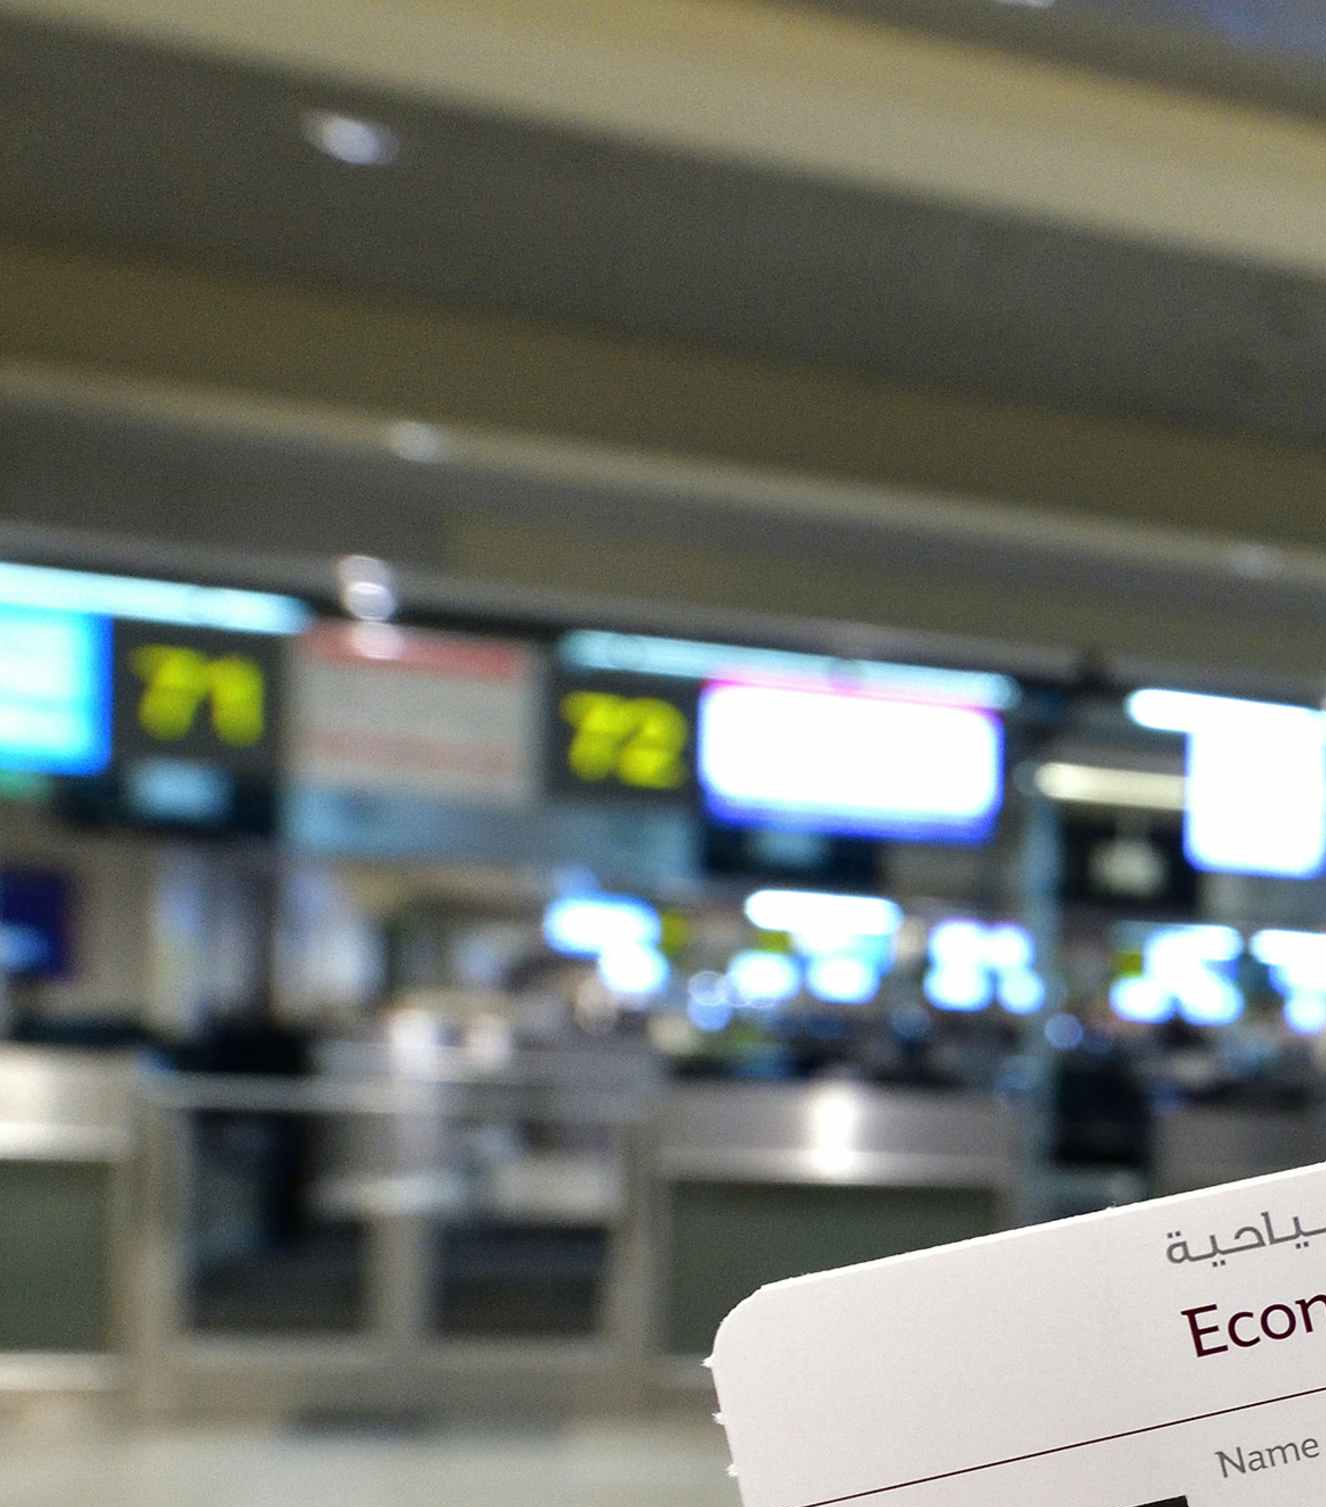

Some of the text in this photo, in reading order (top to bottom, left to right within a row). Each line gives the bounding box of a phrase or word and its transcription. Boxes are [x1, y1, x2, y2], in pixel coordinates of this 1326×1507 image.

[130, 643, 264, 747] 71
[560, 690, 688, 789] 72
[1215, 1429, 1320, 1479] Name
